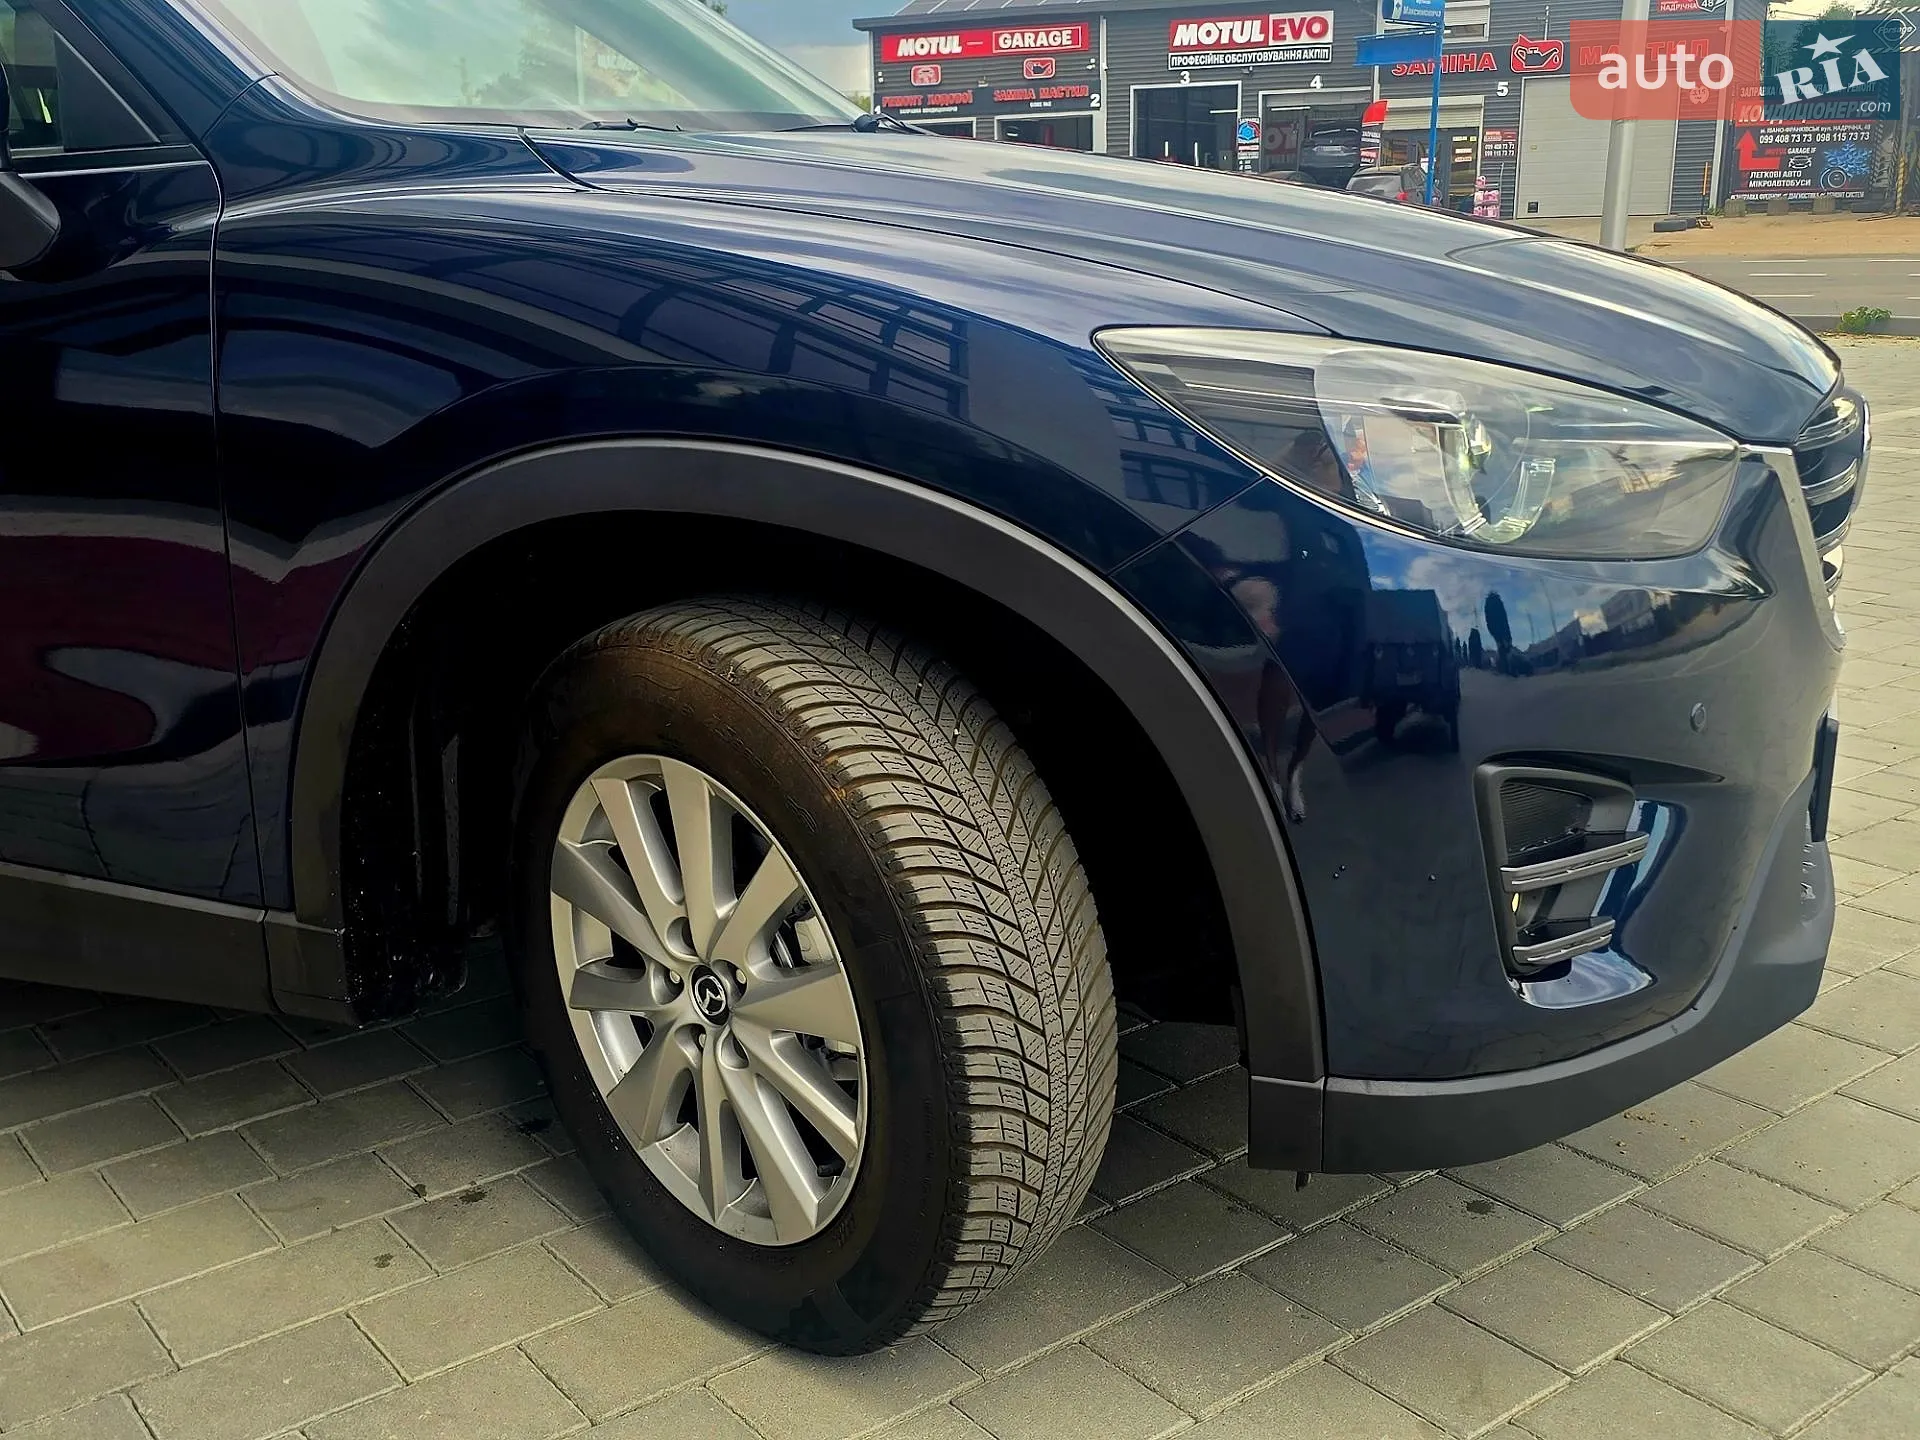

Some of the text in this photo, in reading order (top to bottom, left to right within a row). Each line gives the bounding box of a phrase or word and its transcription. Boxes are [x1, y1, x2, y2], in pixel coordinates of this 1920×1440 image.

[1173, 16, 1329, 46] MOTUL EVO
[897, 30, 1072, 57] MOTUL GARAGE
[1171, 53, 1225, 66] ПРОФЕСІЙНЕ
[1225, 51, 1301, 64] ОБСЛУГОВУВАННЯ
[1580, 39, 1709, 66] МАТИЛ
[1180, 71, 1191, 84] 3
[1310, 75, 1323, 89] 4
[1496, 82, 1509, 97] 5
[1090, 93, 1100, 107] 2
[1759, 131, 1870, 144] 099 408 73 73 098 115 73 73
[1750, 170, 1802, 179] ЛЕГКОВІ АВТО
[1749, 179, 1811, 188] МІКРОАВТОБУСИ
